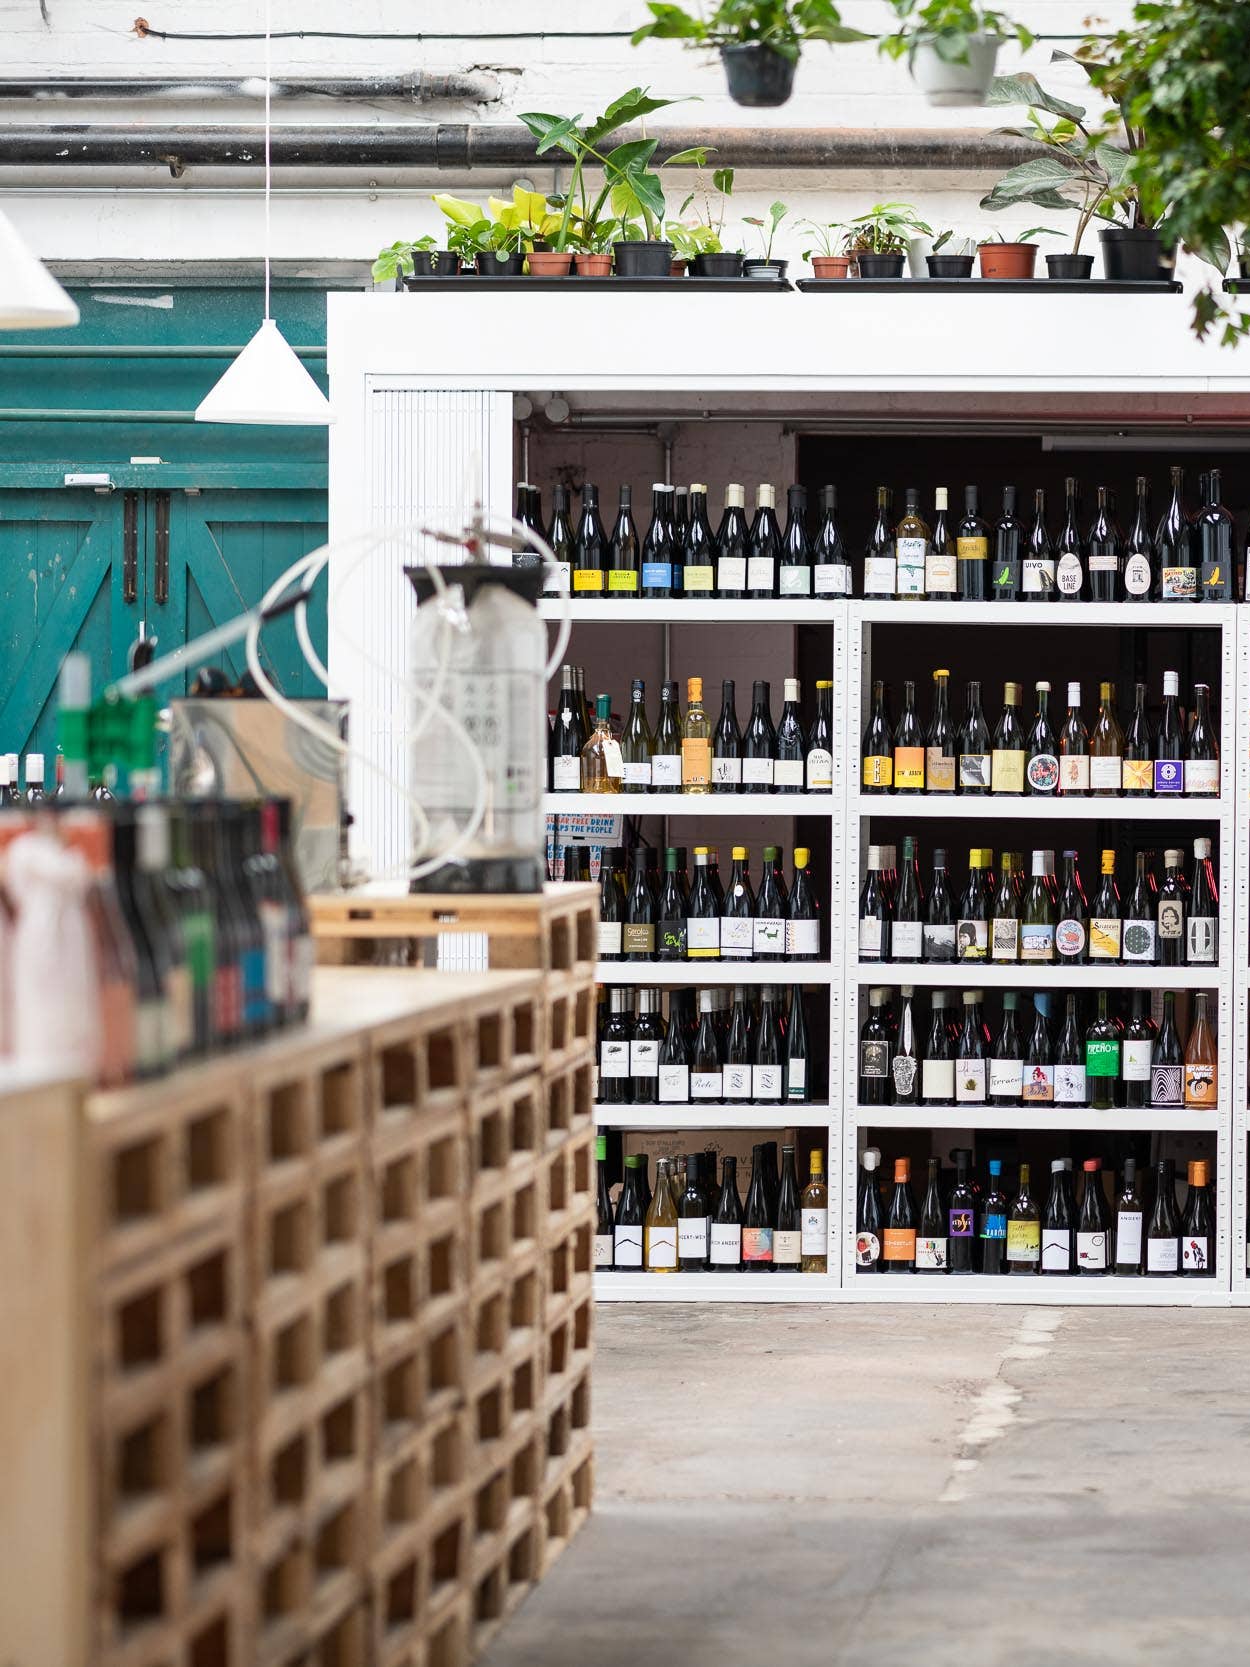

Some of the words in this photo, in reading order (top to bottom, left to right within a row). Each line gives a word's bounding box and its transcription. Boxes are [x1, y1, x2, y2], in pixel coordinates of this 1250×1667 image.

[1061, 574, 1077, 583] BASE
[1063, 582, 1076, 591] LINE
[590, 818, 615, 826] DRINK
[571, 824, 585, 832] THE
[587, 825, 613, 834] PEOPLE
